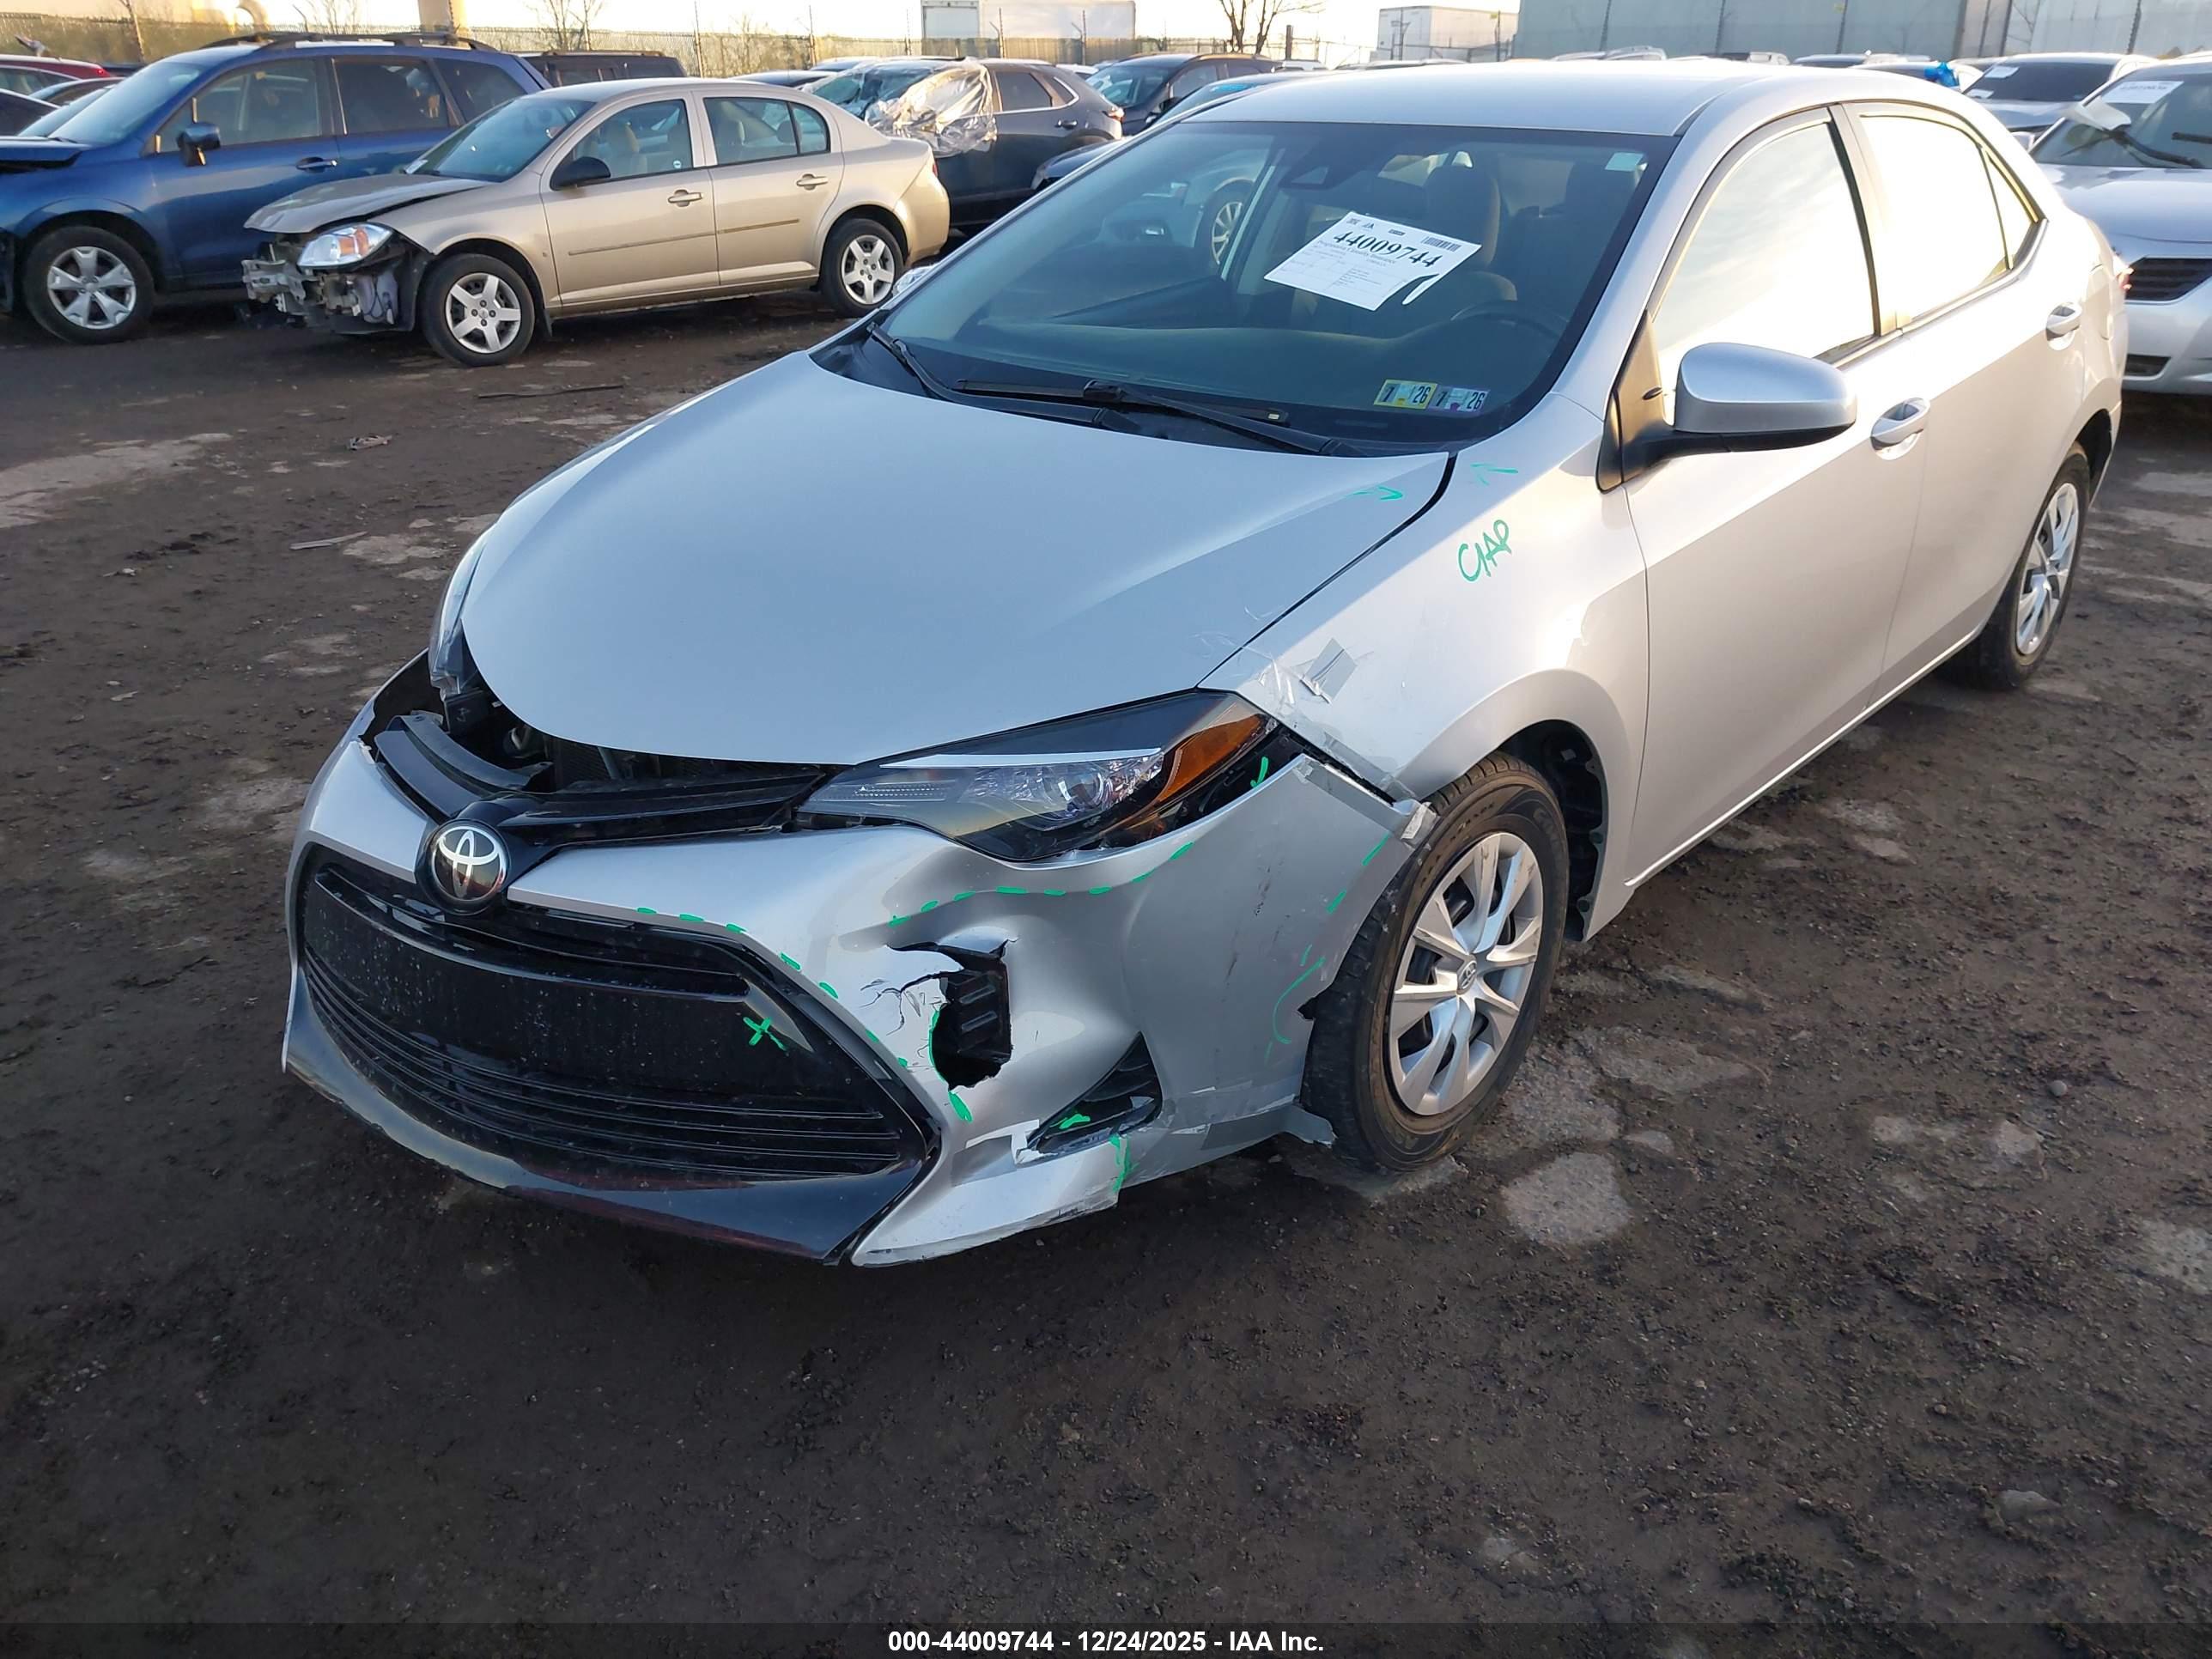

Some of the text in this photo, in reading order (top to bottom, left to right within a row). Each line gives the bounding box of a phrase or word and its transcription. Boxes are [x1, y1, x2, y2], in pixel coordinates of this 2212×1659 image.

[1333, 230, 1444, 268] 44009744
[1412, 386, 1431, 404] 26
[1466, 392, 1486, 410] 26
